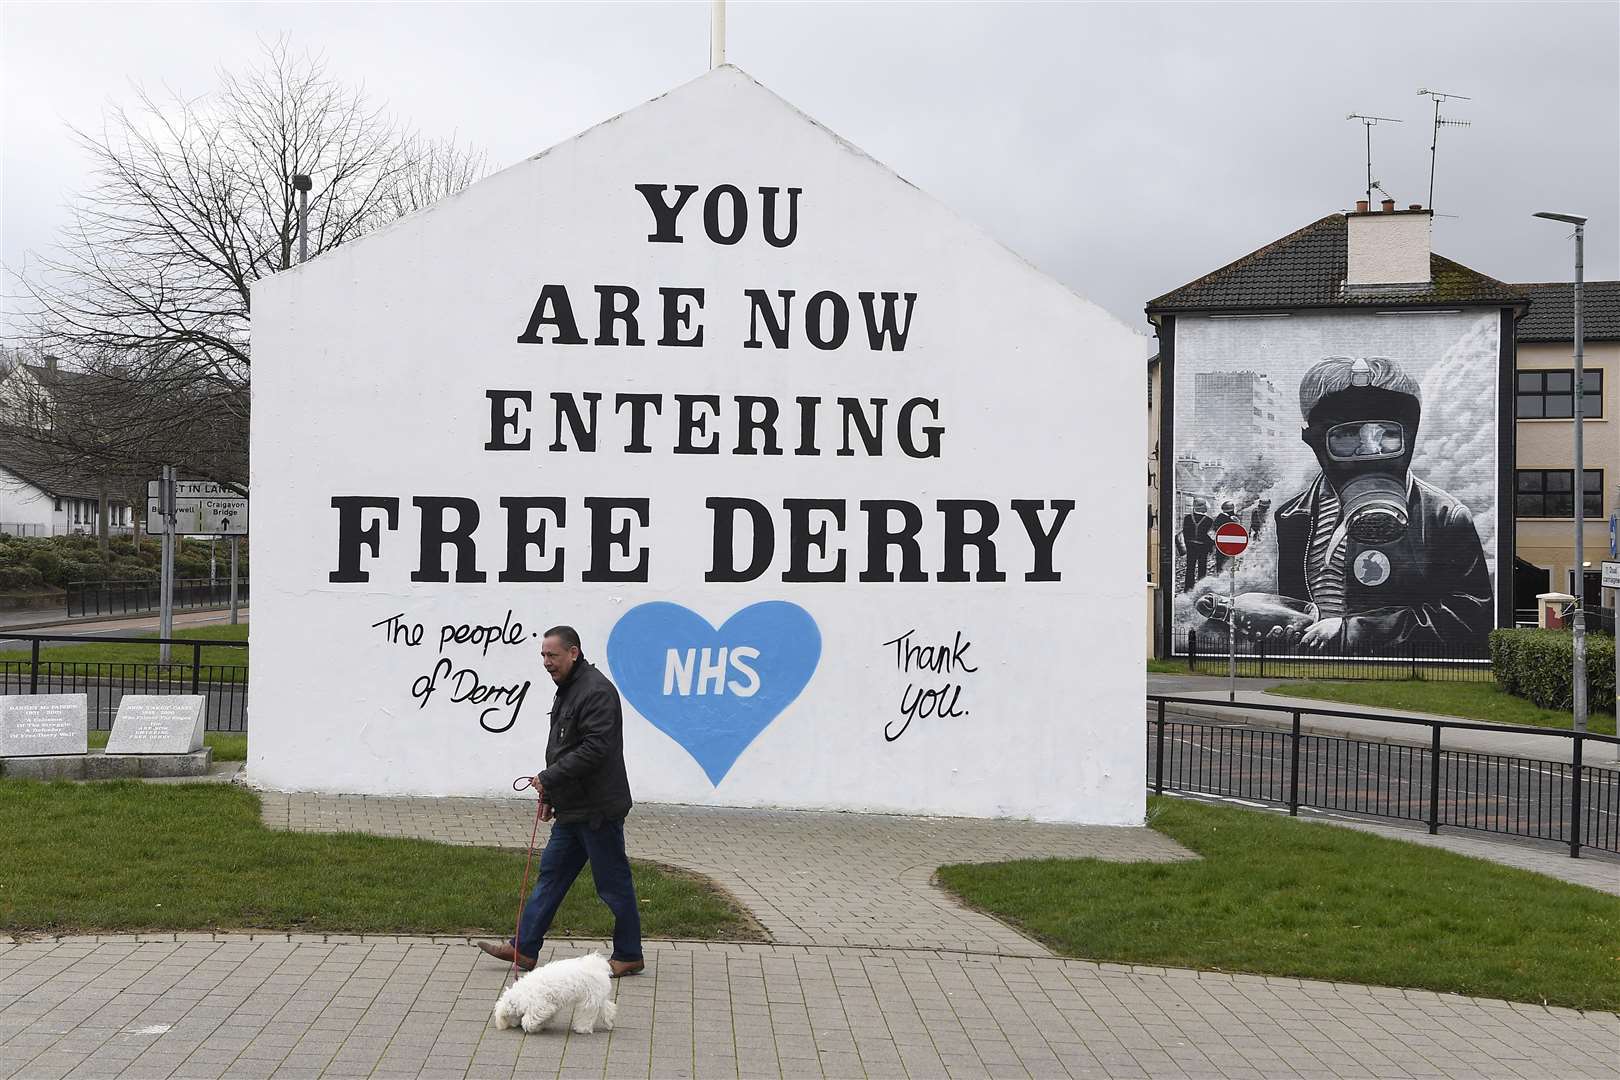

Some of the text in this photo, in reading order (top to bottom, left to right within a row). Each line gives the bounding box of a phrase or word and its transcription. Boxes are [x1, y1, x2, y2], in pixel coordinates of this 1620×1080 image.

[635, 184, 802, 247] YOU
[517, 285, 917, 351] ARE NOW
[485, 390, 945, 458] ENTERING
[206, 500, 246, 509] Craigavon
[212, 508, 239, 517] Bridge
[329, 496, 1075, 583] FREE DERRY
[372, 613, 423, 647] The
[883, 629, 978, 674] Thank
[411, 657, 531, 733] of Derry
[663, 646, 760, 697] NHS
[884, 683, 970, 743] you.
